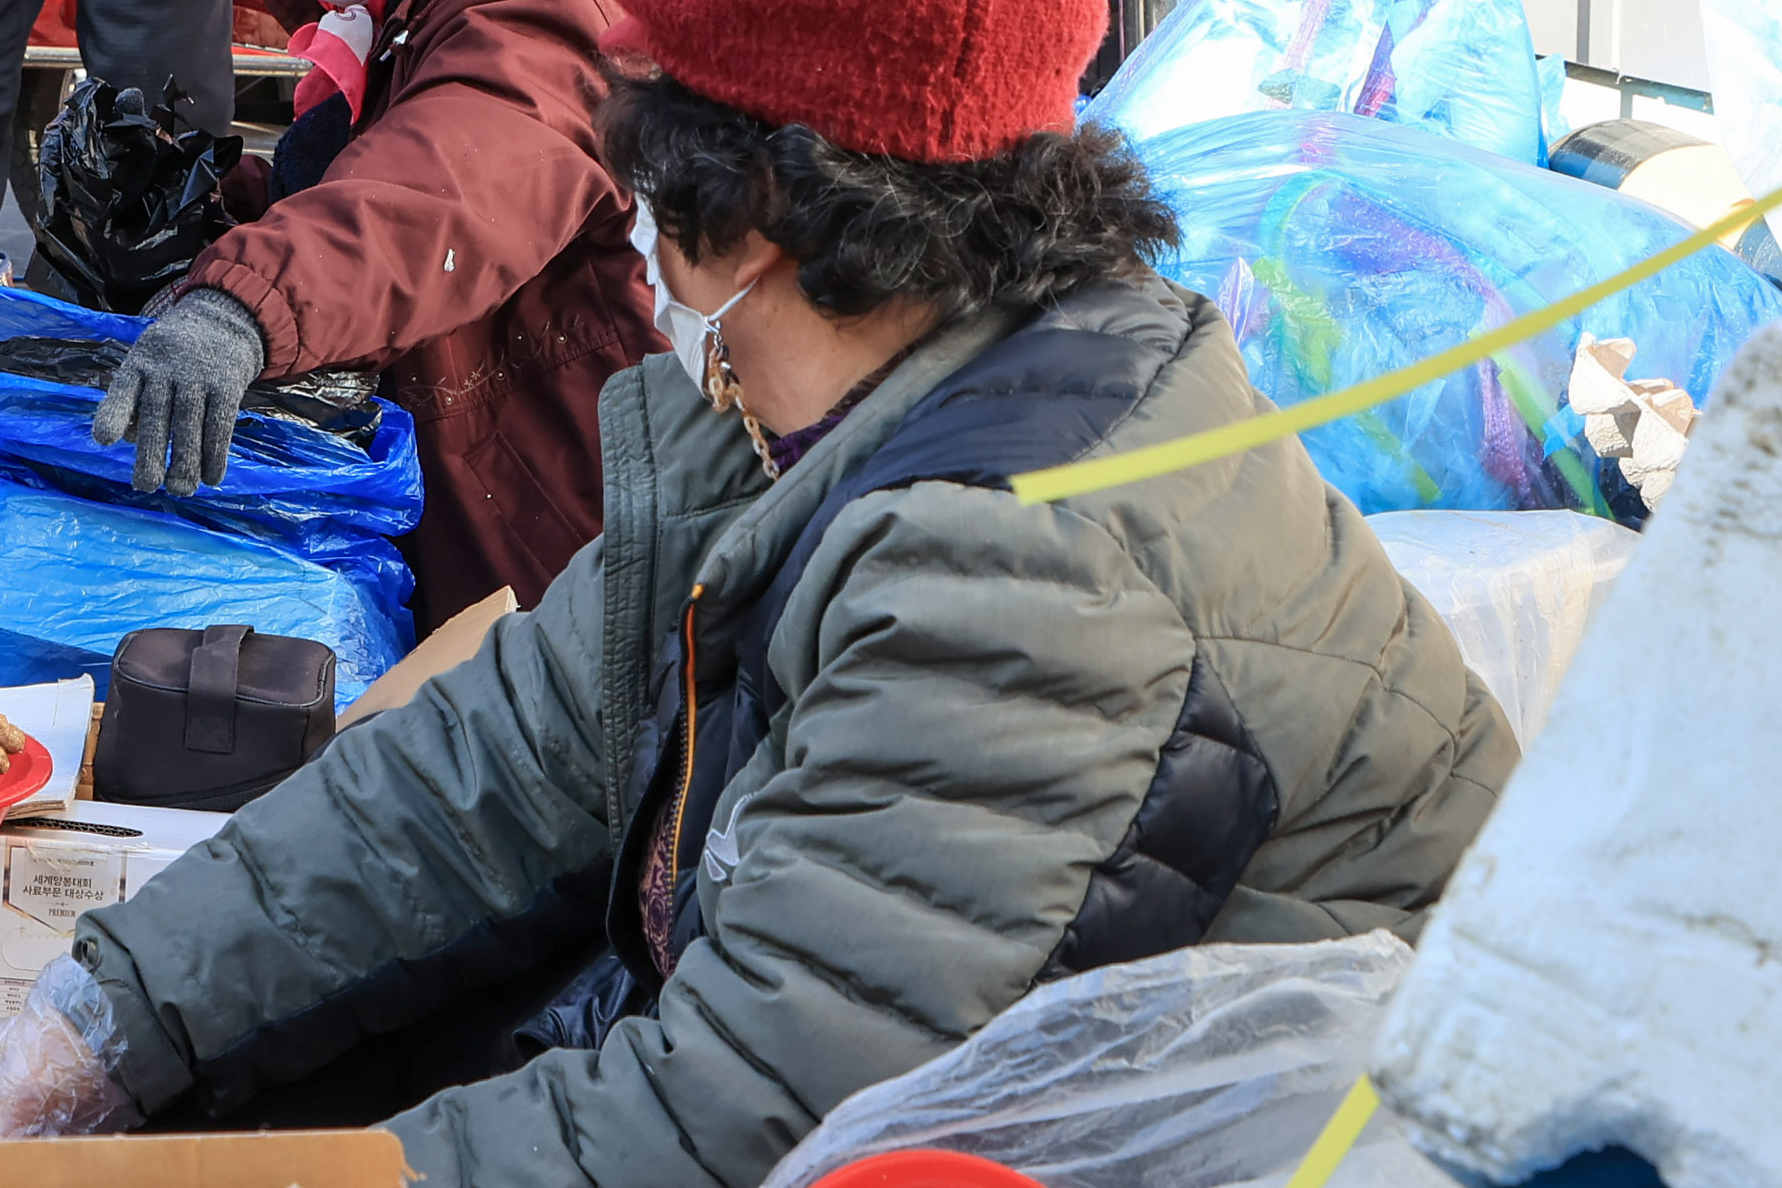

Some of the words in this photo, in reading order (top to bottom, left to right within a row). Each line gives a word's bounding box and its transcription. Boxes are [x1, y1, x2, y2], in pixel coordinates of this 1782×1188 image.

[33, 874, 92, 889] 세계양봉대회
[23, 885, 62, 898] 사료부문
[64, 887, 104, 901] 대상수상
[48, 908, 76, 918] PREMIUM
